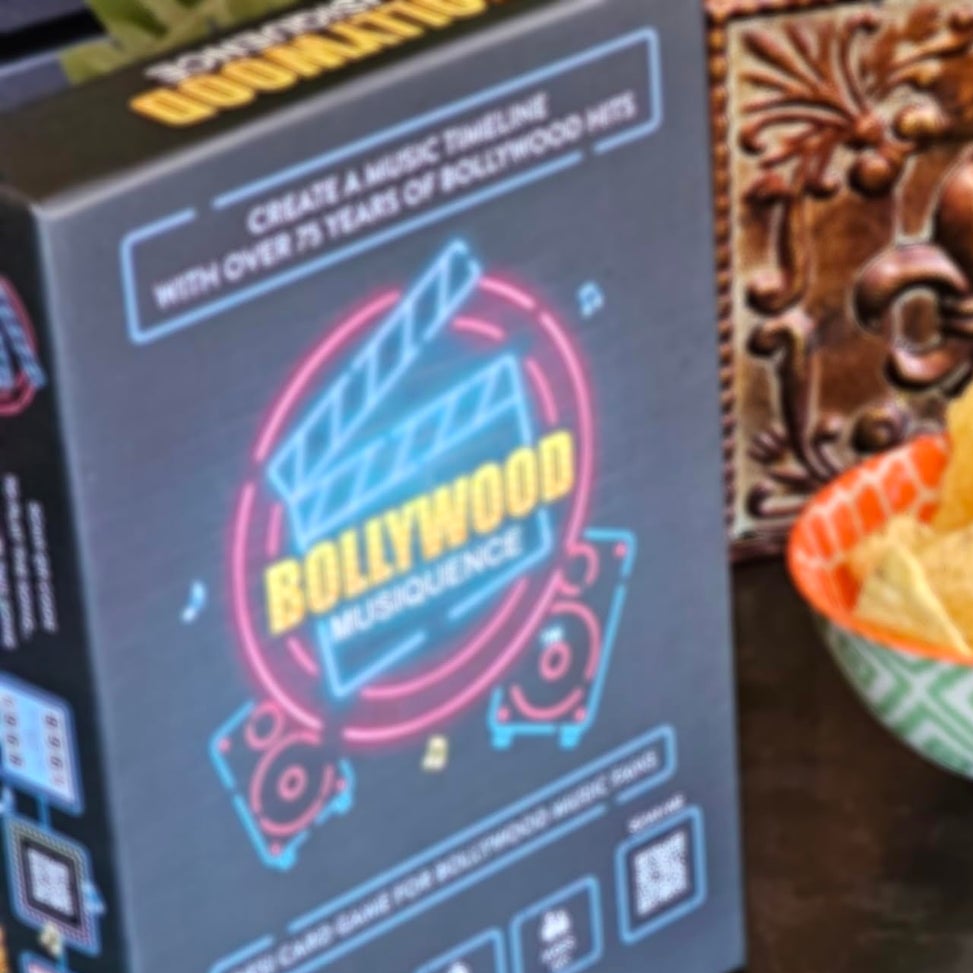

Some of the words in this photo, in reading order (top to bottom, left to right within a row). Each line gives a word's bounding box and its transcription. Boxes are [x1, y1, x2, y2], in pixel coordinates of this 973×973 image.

[154, 260, 221, 309] WITH
[223, 231, 292, 282] OVER
[324, 186, 399, 239] YEARS
[402, 171, 435, 207] OF
[440, 113, 584, 193] BOLLYWOOD
[585, 88, 637, 133] HITS
[247, 178, 339, 235] CREATE
[342, 167, 361, 196] A
[363, 135, 440, 186] MUSIC
[443, 91, 548, 154] TIMELINE
[264, 429, 575, 636] BOLLYWOOD
[328, 524, 524, 642] MUSIQUENCE
